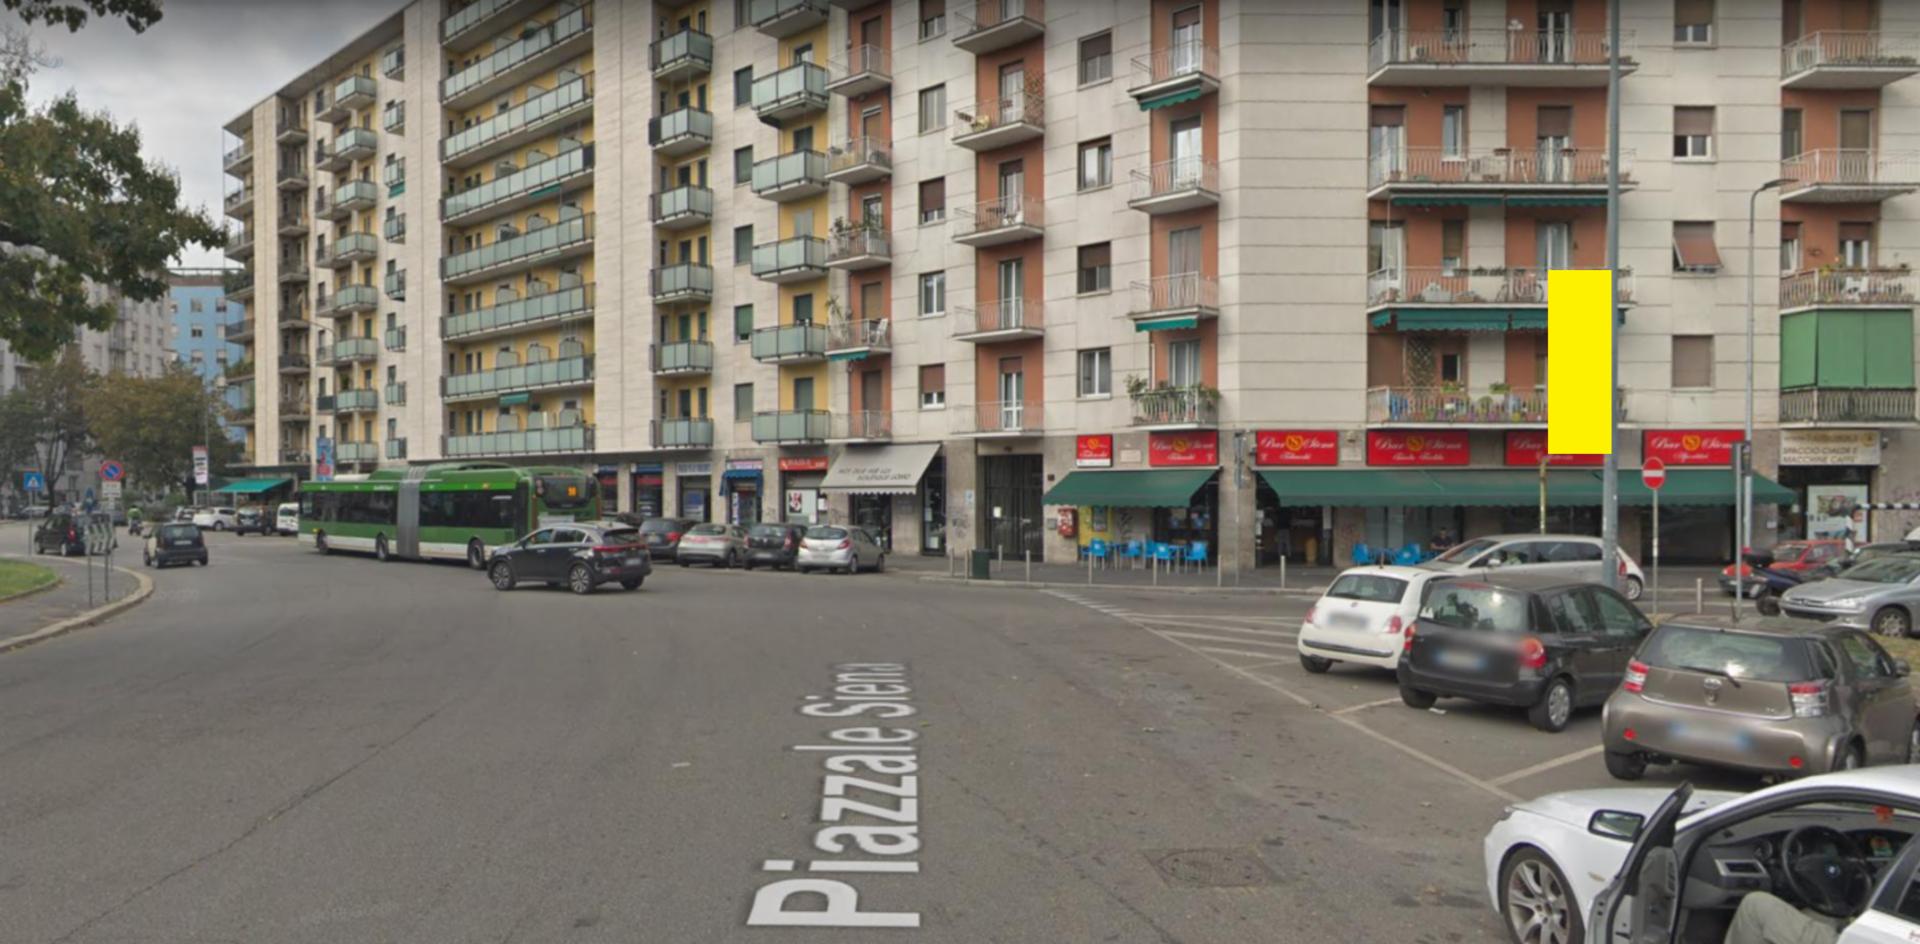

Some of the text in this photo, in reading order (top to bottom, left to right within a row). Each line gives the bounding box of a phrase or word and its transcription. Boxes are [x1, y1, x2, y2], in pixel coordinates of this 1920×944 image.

[1261, 437, 1286, 449] Bar
[1303, 437, 1335, 449] Siena
[1375, 437, 1462, 450] Bar Siena
[1651, 437, 1680, 449] Bar
[1701, 437, 1733, 449] Sien
